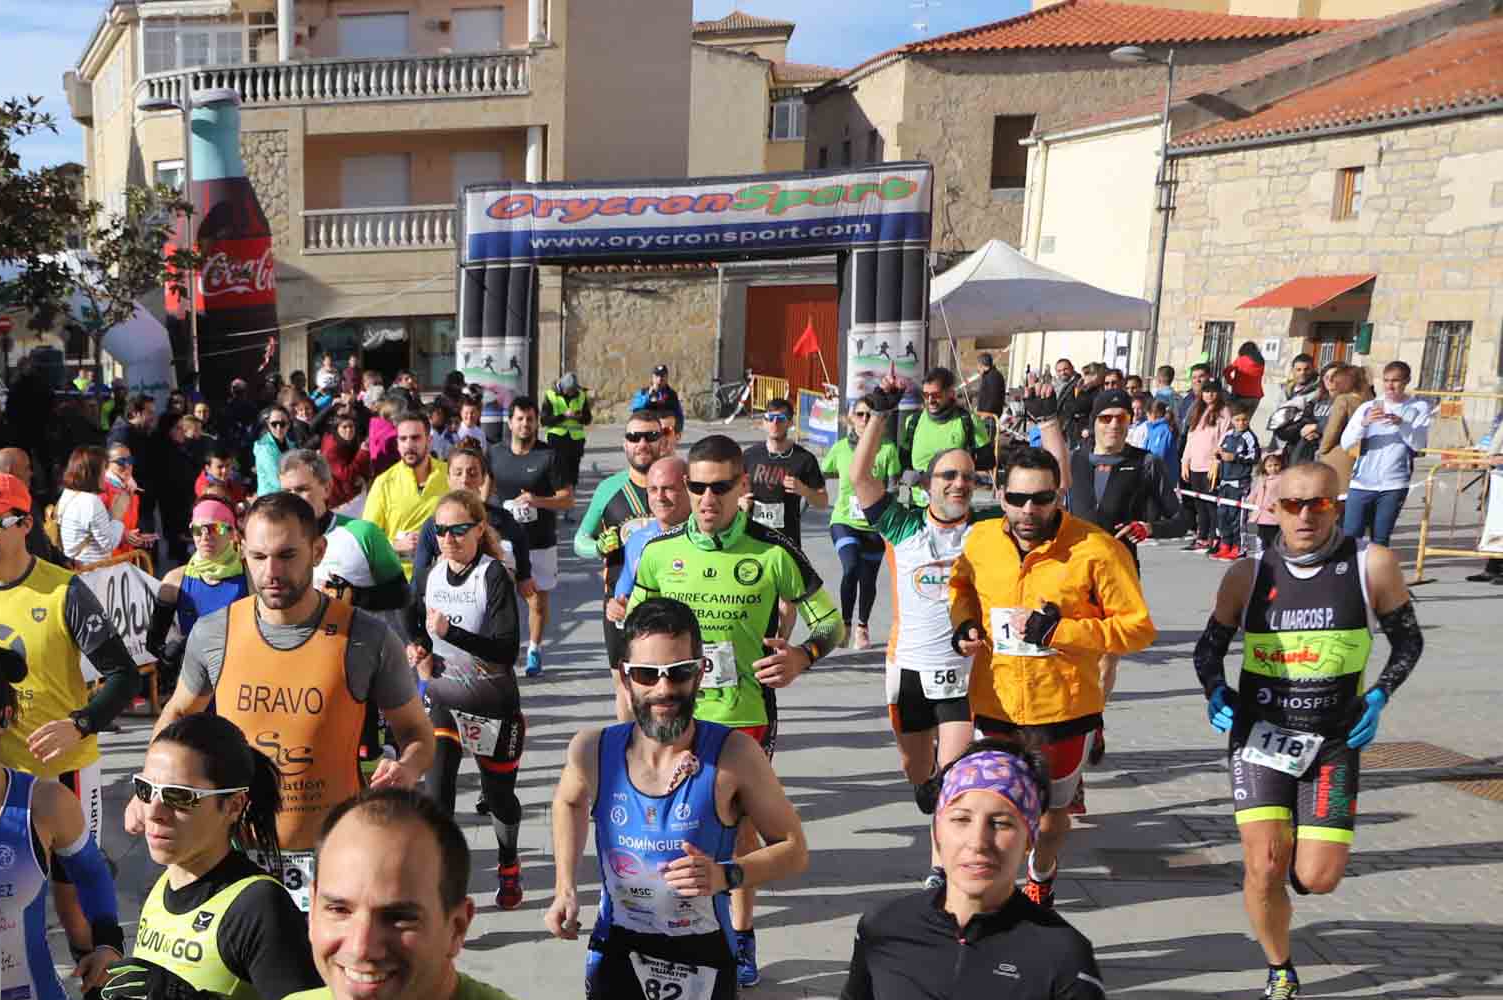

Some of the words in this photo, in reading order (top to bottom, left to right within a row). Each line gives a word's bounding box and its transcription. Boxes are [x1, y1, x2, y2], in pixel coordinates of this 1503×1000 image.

[530, 221, 872, 249] www.orycronsport.com
[664, 590, 762, 605] TORRECAMINOS
[1281, 607, 1324, 630] MARCOS
[237, 684, 323, 715] BRAVO
[1278, 696, 1338, 710] HOSPES
[1261, 731, 1304, 758] 118
[629, 887, 652, 897] MSC
